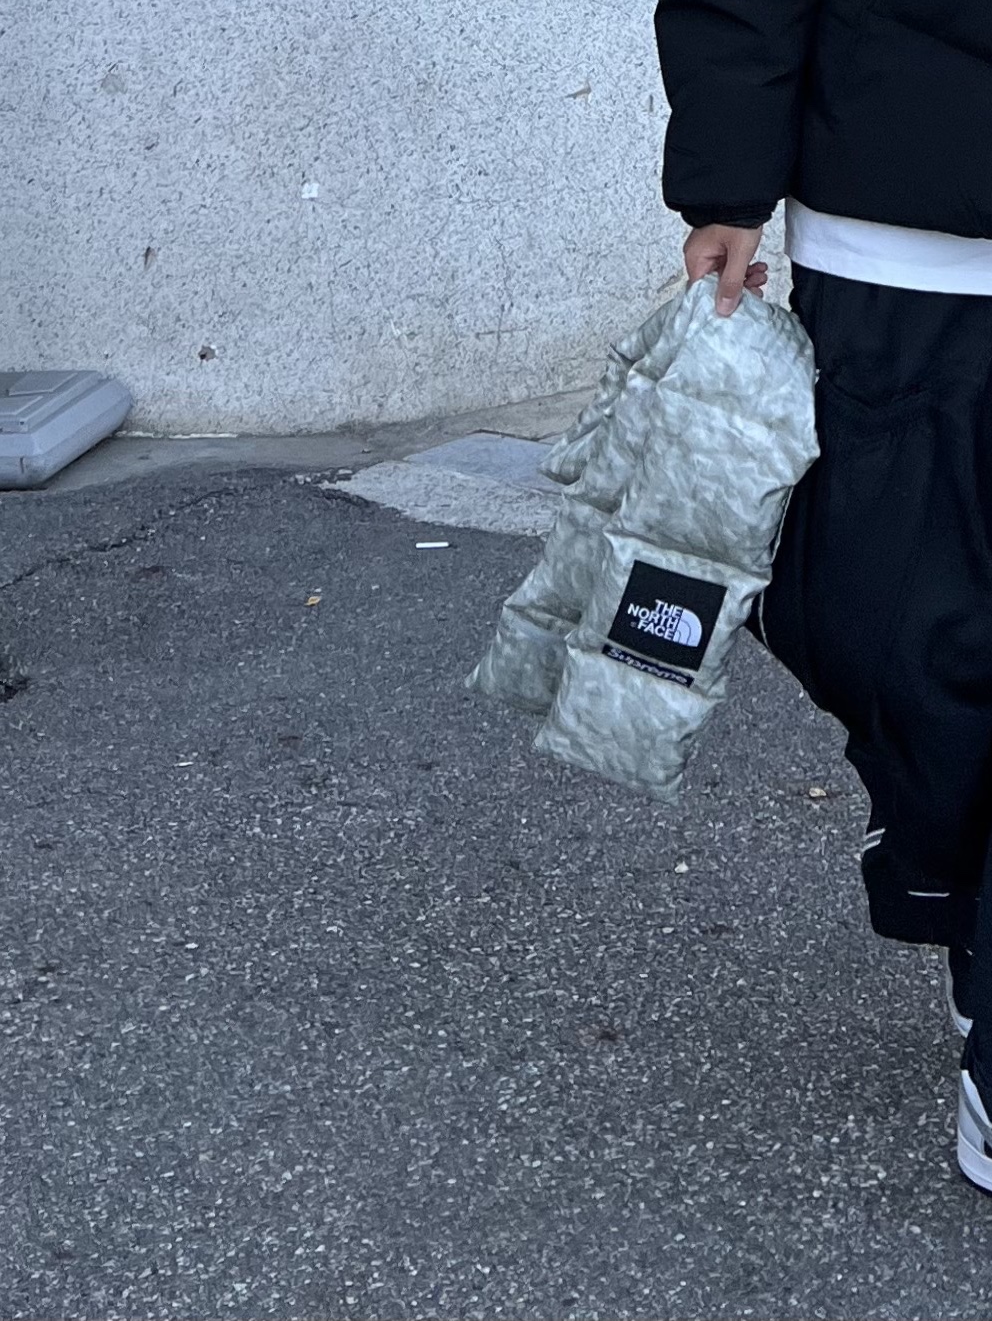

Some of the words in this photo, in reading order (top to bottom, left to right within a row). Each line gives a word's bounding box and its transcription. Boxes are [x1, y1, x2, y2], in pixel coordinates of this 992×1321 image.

[627, 603, 678, 629] NORTH
[655, 599, 682, 619] THE
[638, 619, 674, 641] FACE
[607, 647, 688, 684] Supreme
